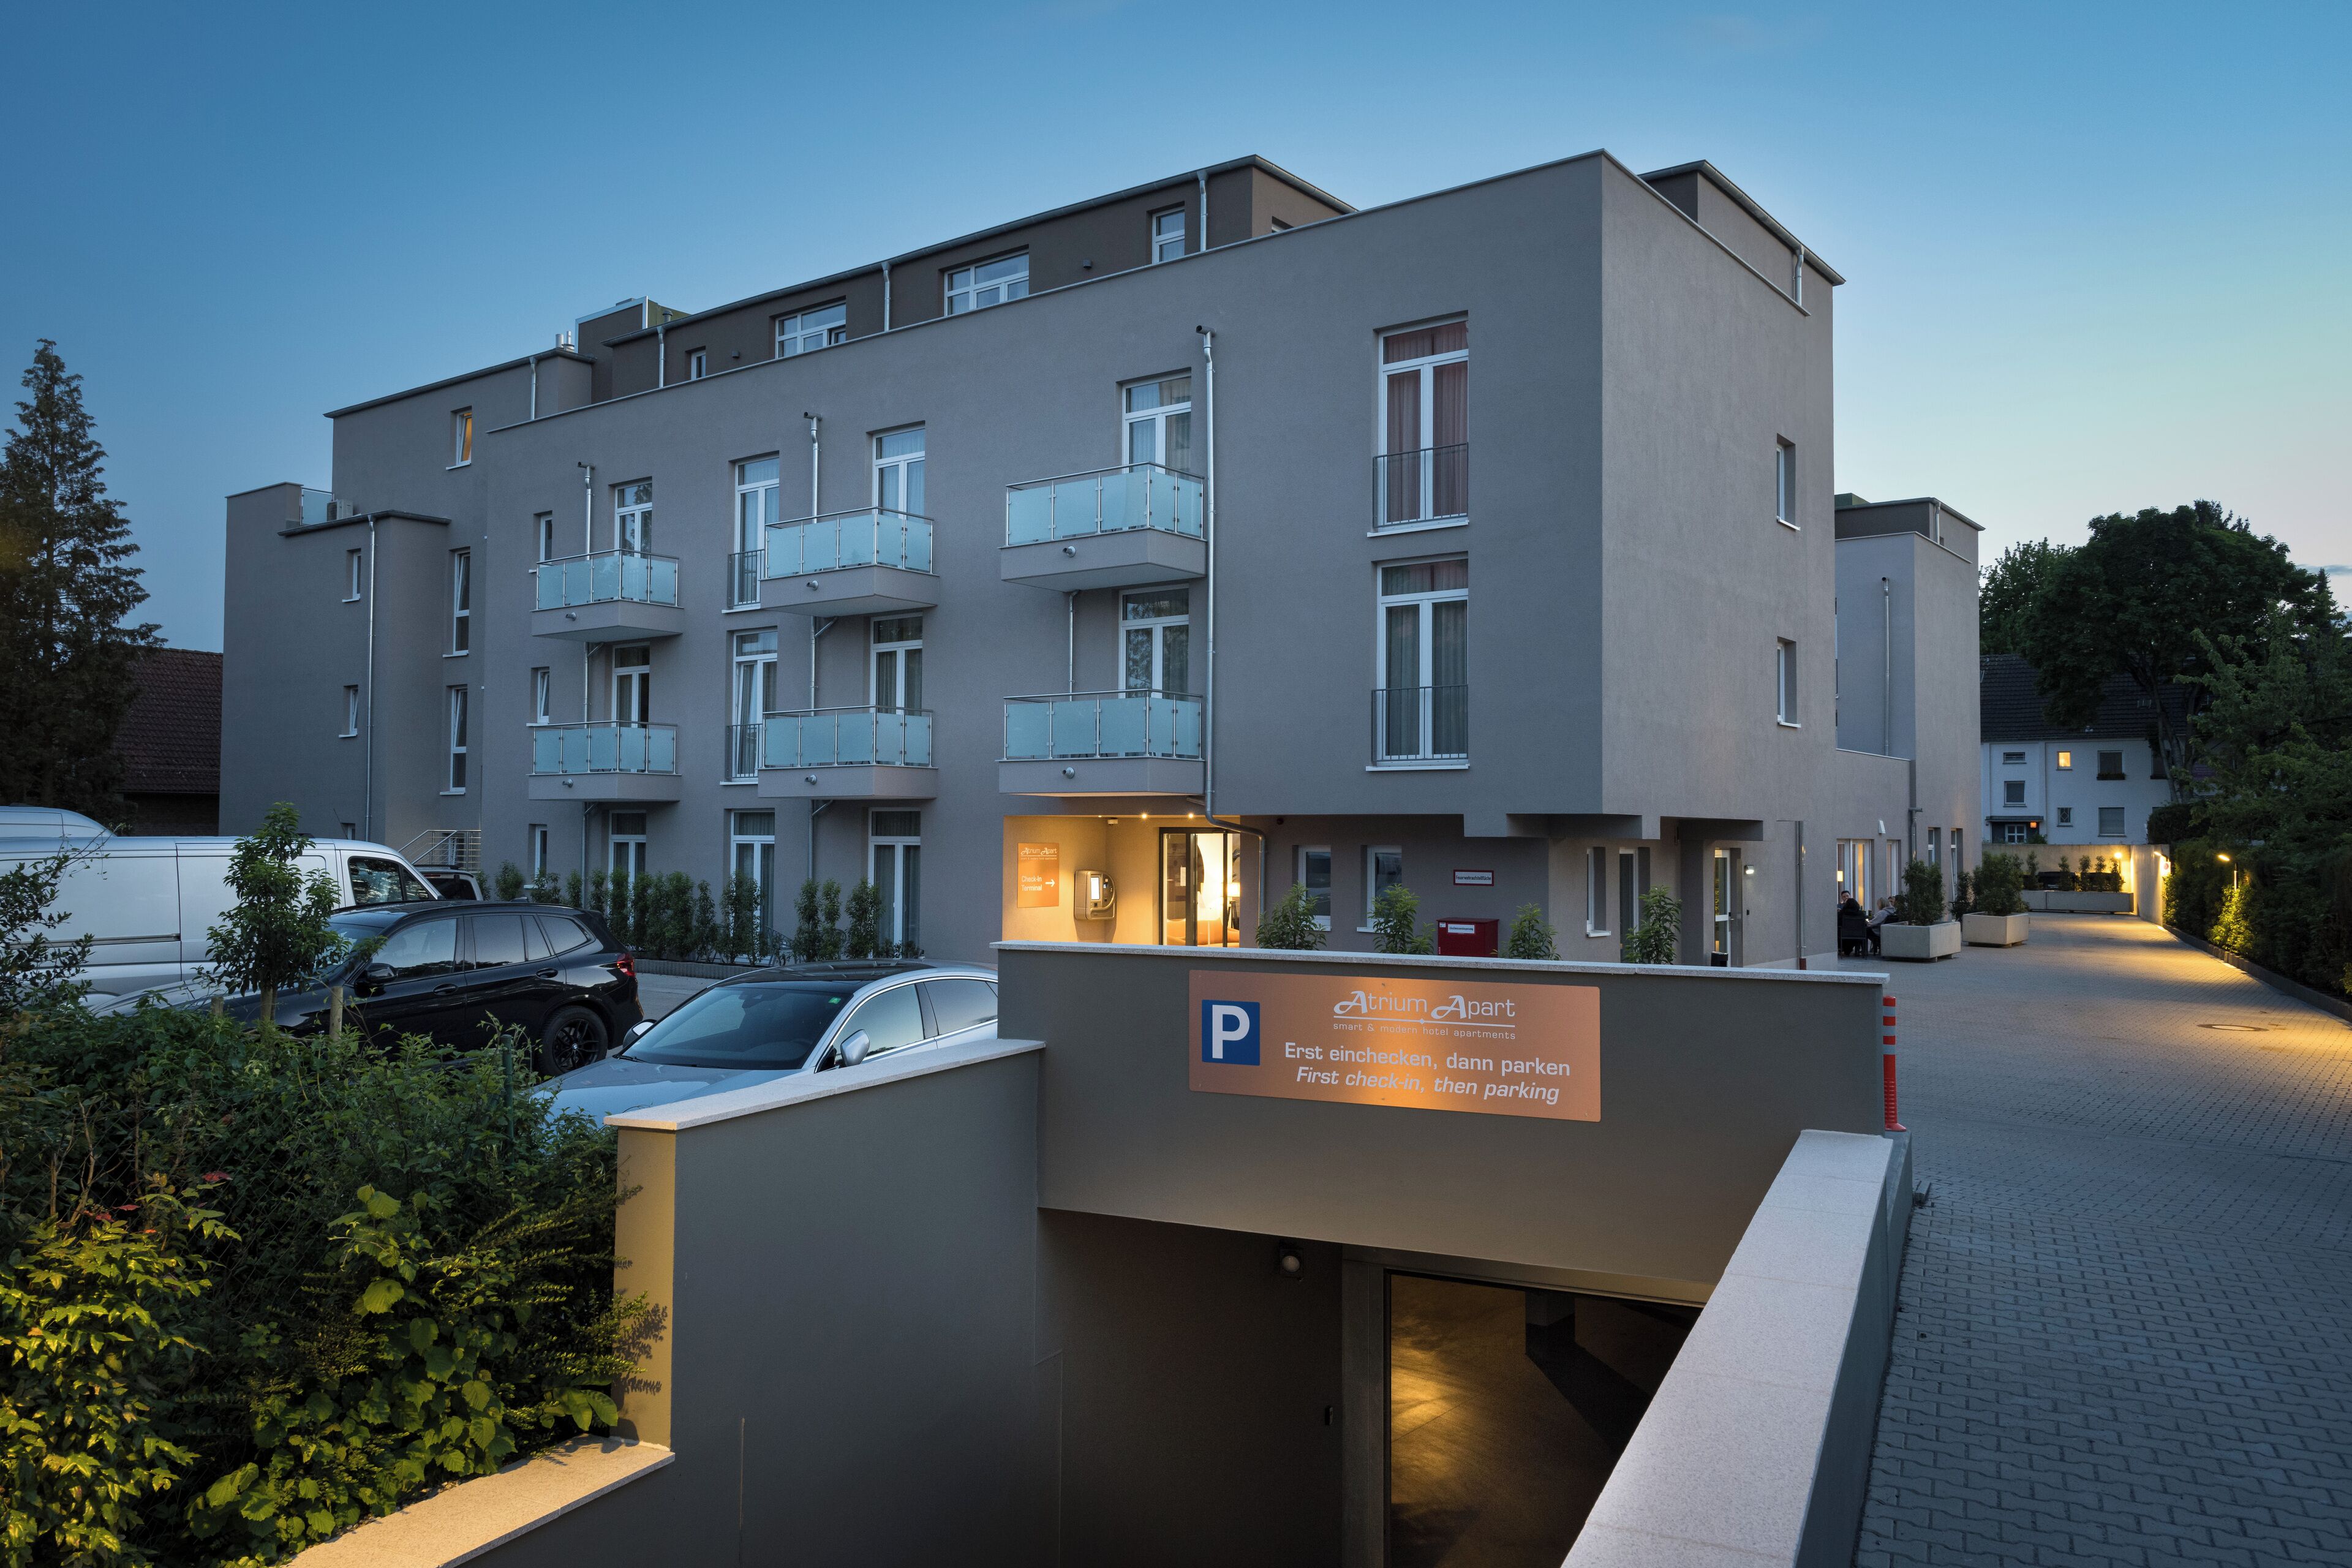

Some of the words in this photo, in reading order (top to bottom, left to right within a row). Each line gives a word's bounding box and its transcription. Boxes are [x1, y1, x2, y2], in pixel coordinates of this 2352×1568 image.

[1333, 990, 1427, 1014] Atrium
[1430, 995, 1515, 1020] Apart
[1212, 1005, 1250, 1059] P
[1380, 1025, 1418, 1035] modern
[1423, 1027, 1449, 1036] hotel
[1453, 1030, 1515, 1039] apartments
[1285, 1042, 1324, 1060] Erst
[1329, 1045, 1438, 1070] einchecken,
[1446, 1052, 1493, 1071] dann
[1501, 1057, 1570, 1077] parken
[1296, 1066, 1340, 1085] First
[1345, 1070, 1425, 1093] check-in,
[1434, 1076, 1477, 1095] then
[1483, 1082, 1560, 1105] parking
